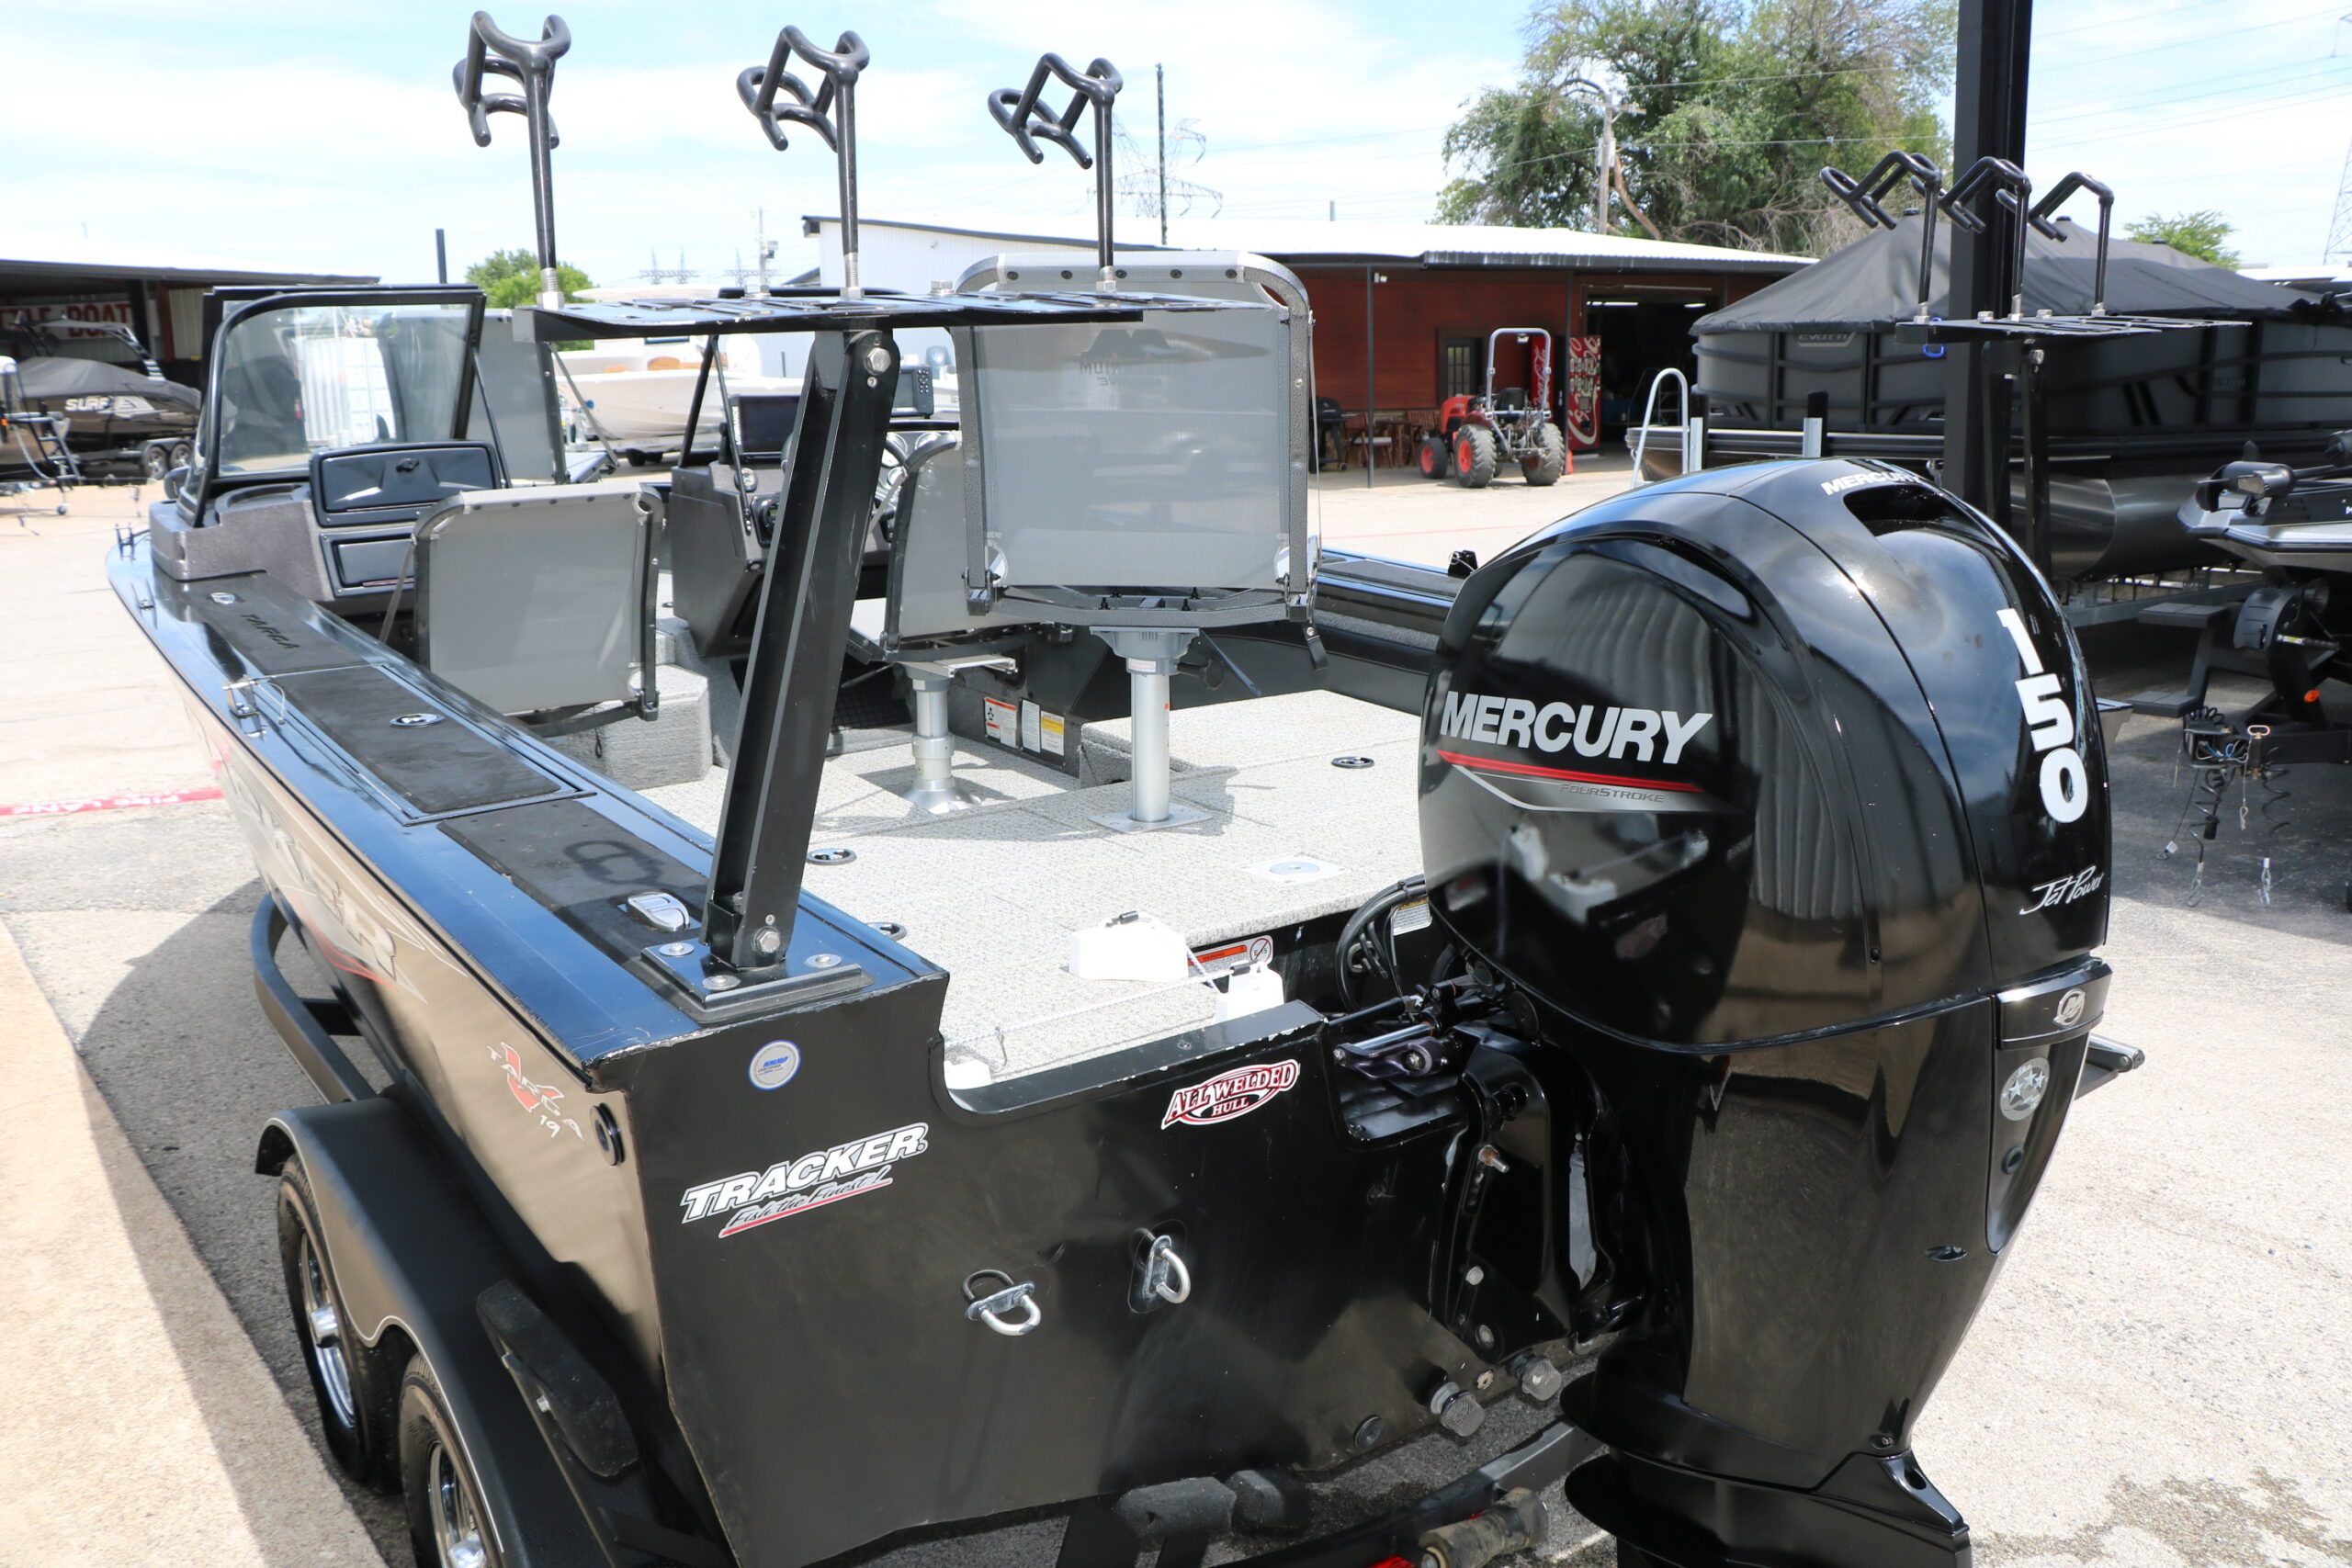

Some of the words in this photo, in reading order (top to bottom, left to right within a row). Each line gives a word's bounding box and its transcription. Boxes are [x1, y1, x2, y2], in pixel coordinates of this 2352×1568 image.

[66, 303, 130, 337] BOAT
[1821, 472, 1921, 496] MERCURY
[1439, 690, 1713, 764] MERCURY
[1996, 607, 2088, 823] 150
[12, 800, 103, 814] LANE
[115, 795, 181, 807] FIRE
[486, 1044, 583, 1141] TARGA
[1164, 1086, 1210, 1124] ALL
[1213, 1062, 1295, 1100] WELDED
[1210, 1096, 1250, 1117] HULL
[539, 1114, 560, 1138] 19
[682, 1124, 926, 1223] TRACKER
[728, 1206, 770, 1227] Fish
[775, 1195, 805, 1213] the
